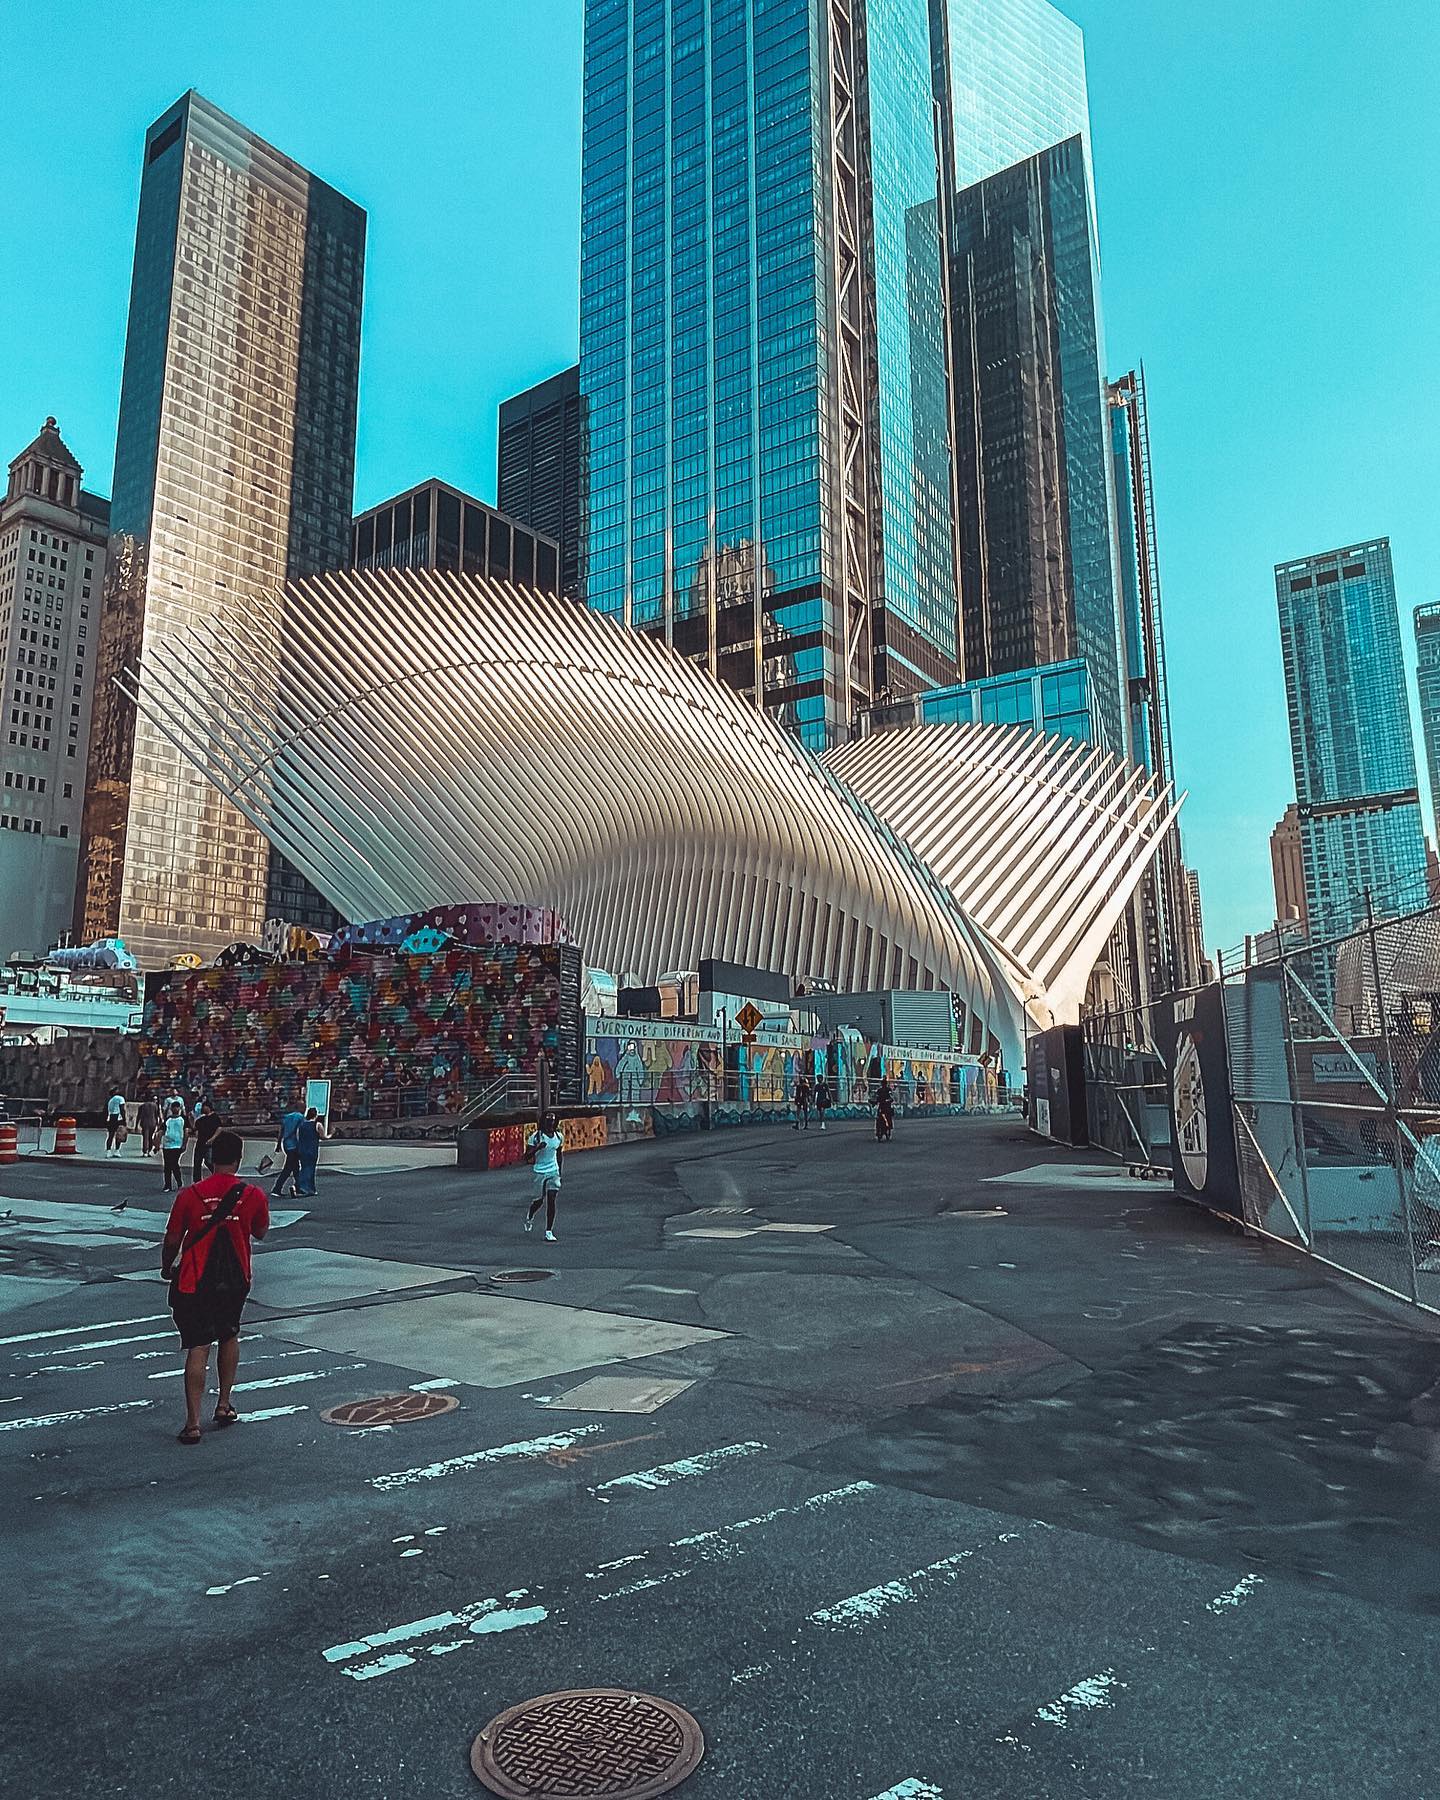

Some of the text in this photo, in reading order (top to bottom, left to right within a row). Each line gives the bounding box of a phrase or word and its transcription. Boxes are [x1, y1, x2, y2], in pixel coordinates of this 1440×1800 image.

[595, 1017, 657, 1037] EVERYONE'S
[663, 1026, 705, 1039] DIFFERENT
[708, 1029, 720, 1040] AND
[781, 1035, 797, 1046] SAME
